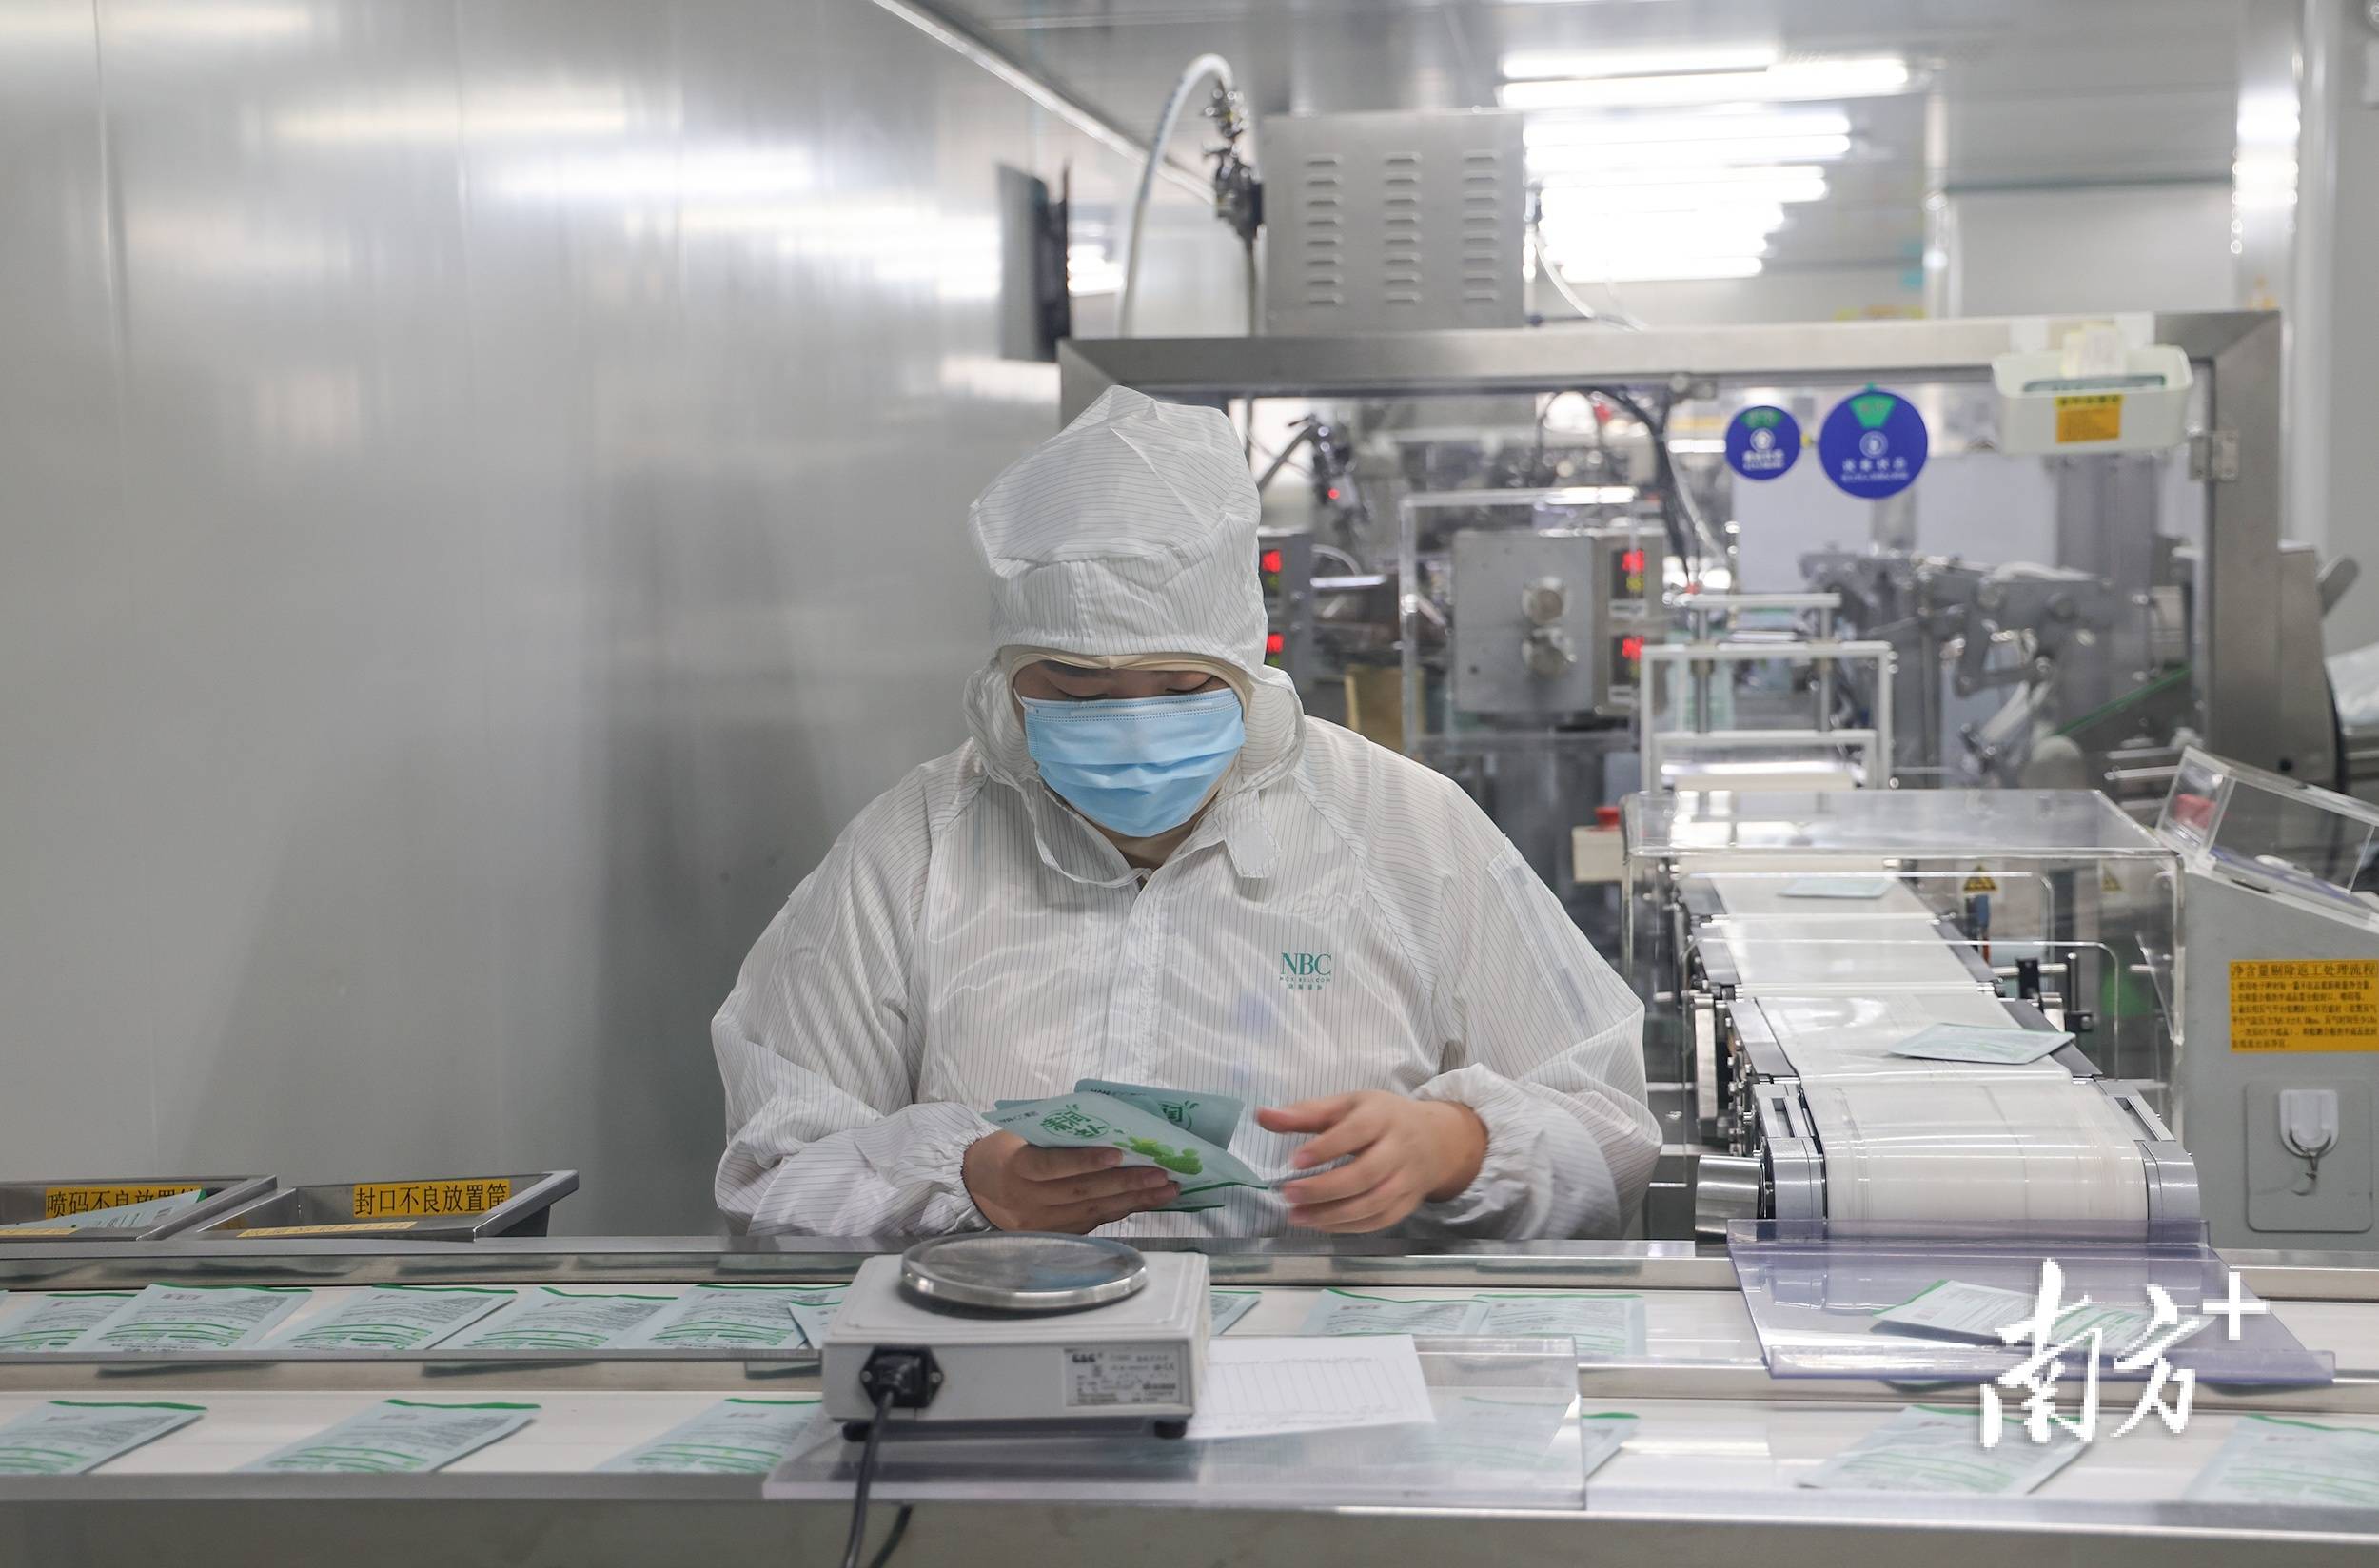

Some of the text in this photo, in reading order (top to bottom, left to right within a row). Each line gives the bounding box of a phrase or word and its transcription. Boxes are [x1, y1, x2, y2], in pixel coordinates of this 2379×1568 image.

[1281, 952, 1332, 975] NBC
[355, 1183, 507, 1215] 封口不良放置筐
